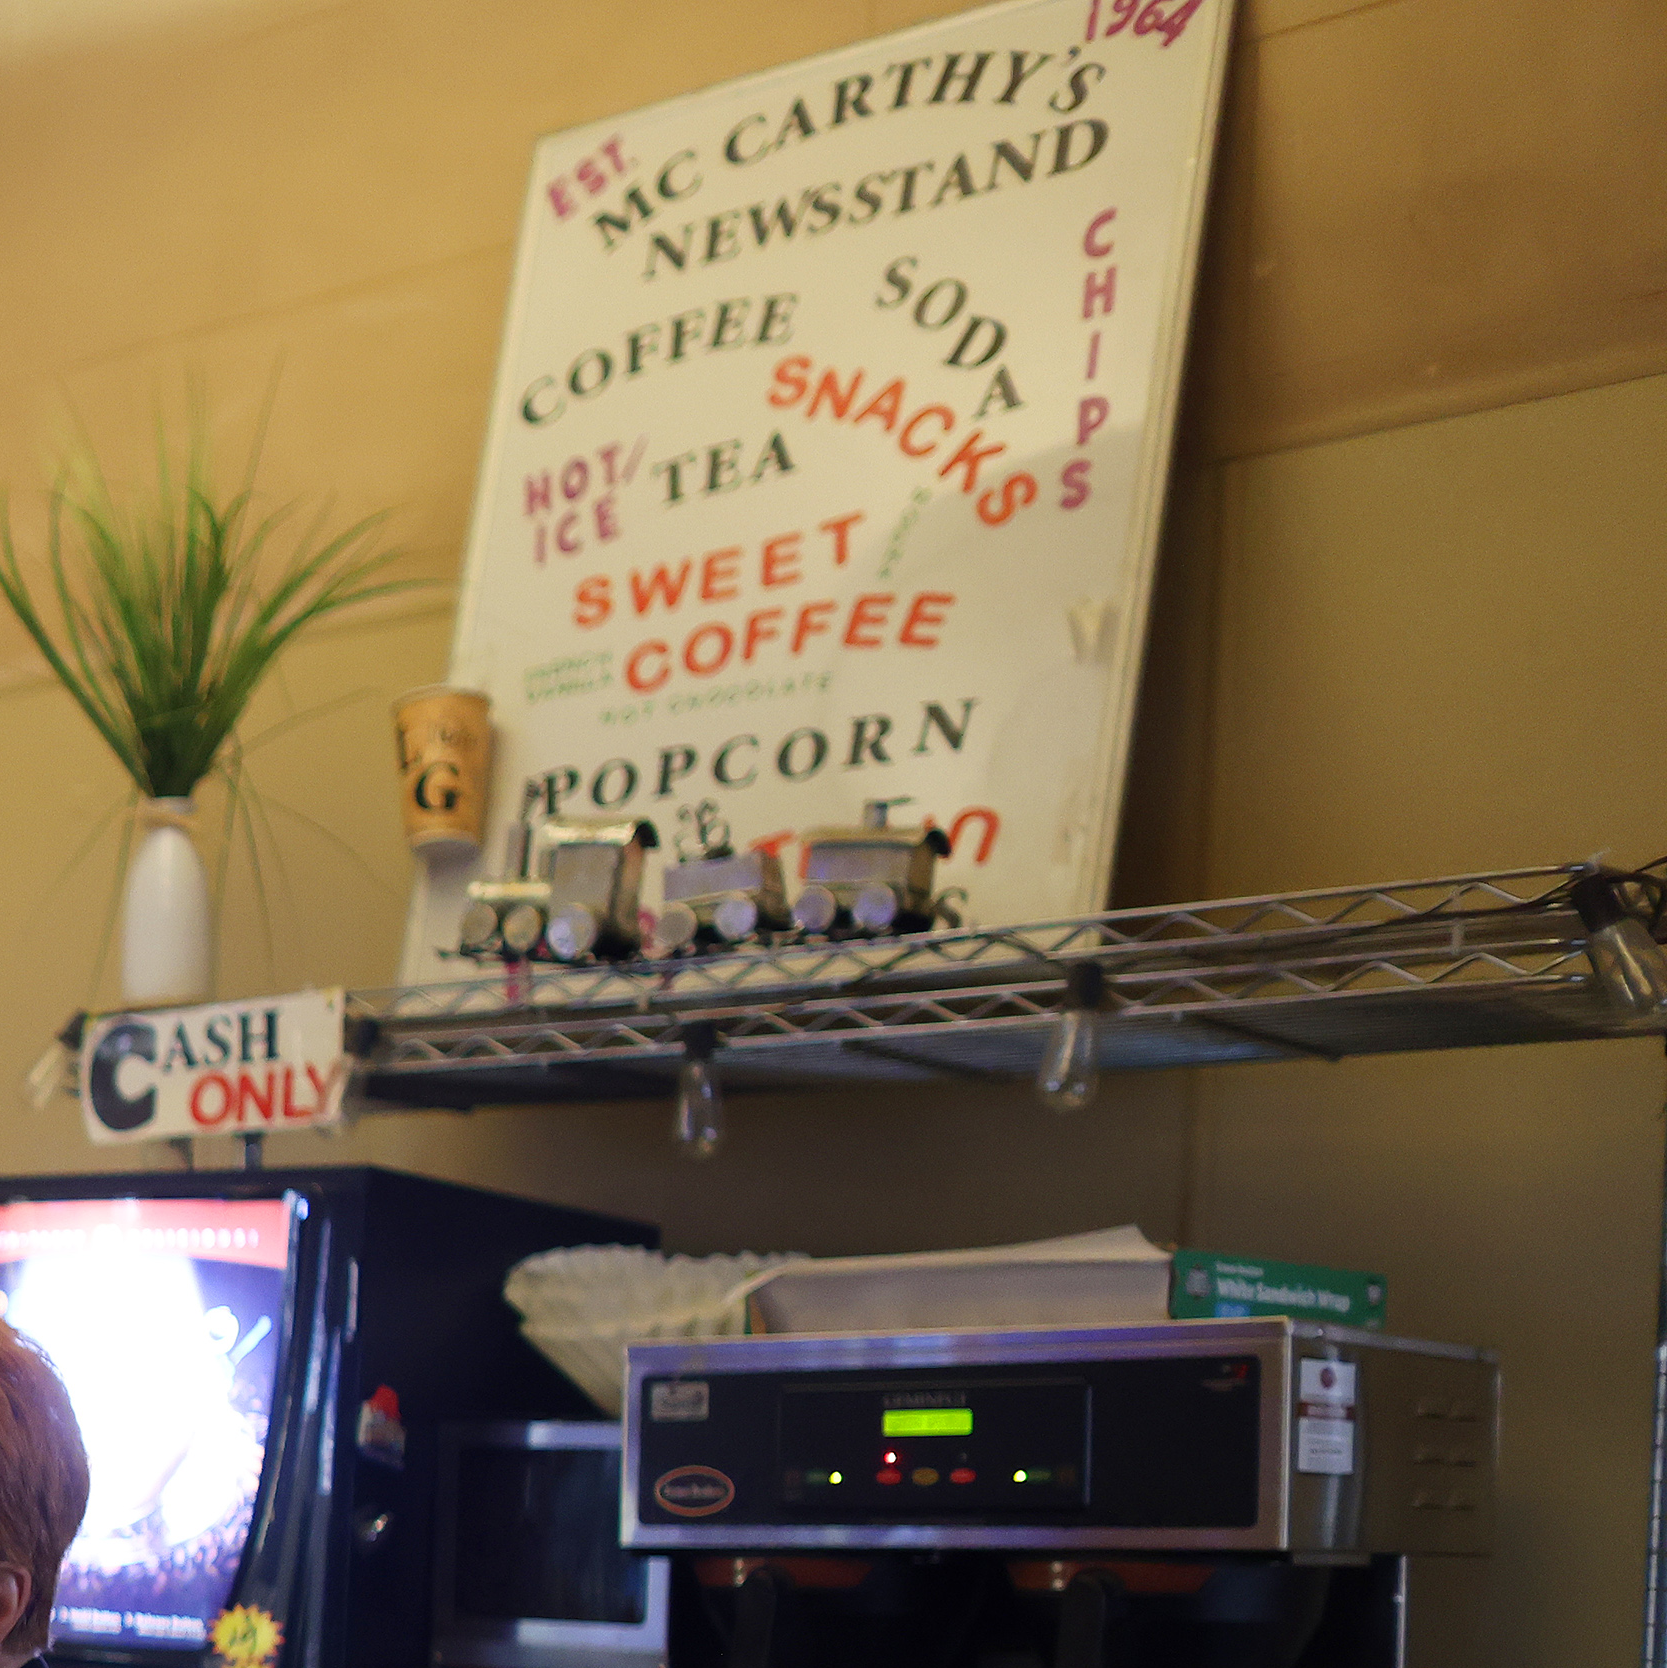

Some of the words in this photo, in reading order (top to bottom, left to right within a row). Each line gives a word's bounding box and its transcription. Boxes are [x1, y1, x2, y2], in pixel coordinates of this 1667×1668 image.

[1086, 0, 1202, 47] 1964
[591, 150, 704, 252] MC
[723, 46, 1105, 167] CARTHY'S
[641, 117, 1110, 281] NEWSSTAND
[519, 292, 798, 428] COFFEE
[875, 255, 1023, 421] SODA
[1059, 207, 1118, 511] CHIPS
[654, 431, 795, 506] TEA
[766, 353, 1038, 527] SNACKS
[532, 495, 618, 565] ICE
[572, 512, 866, 629] SWEET
[624, 592, 956, 693] COFFEE
[539, 696, 980, 816] POPCORN
[90, 1008, 284, 1132] CASH
[189, 1060, 345, 1128] ONLY
